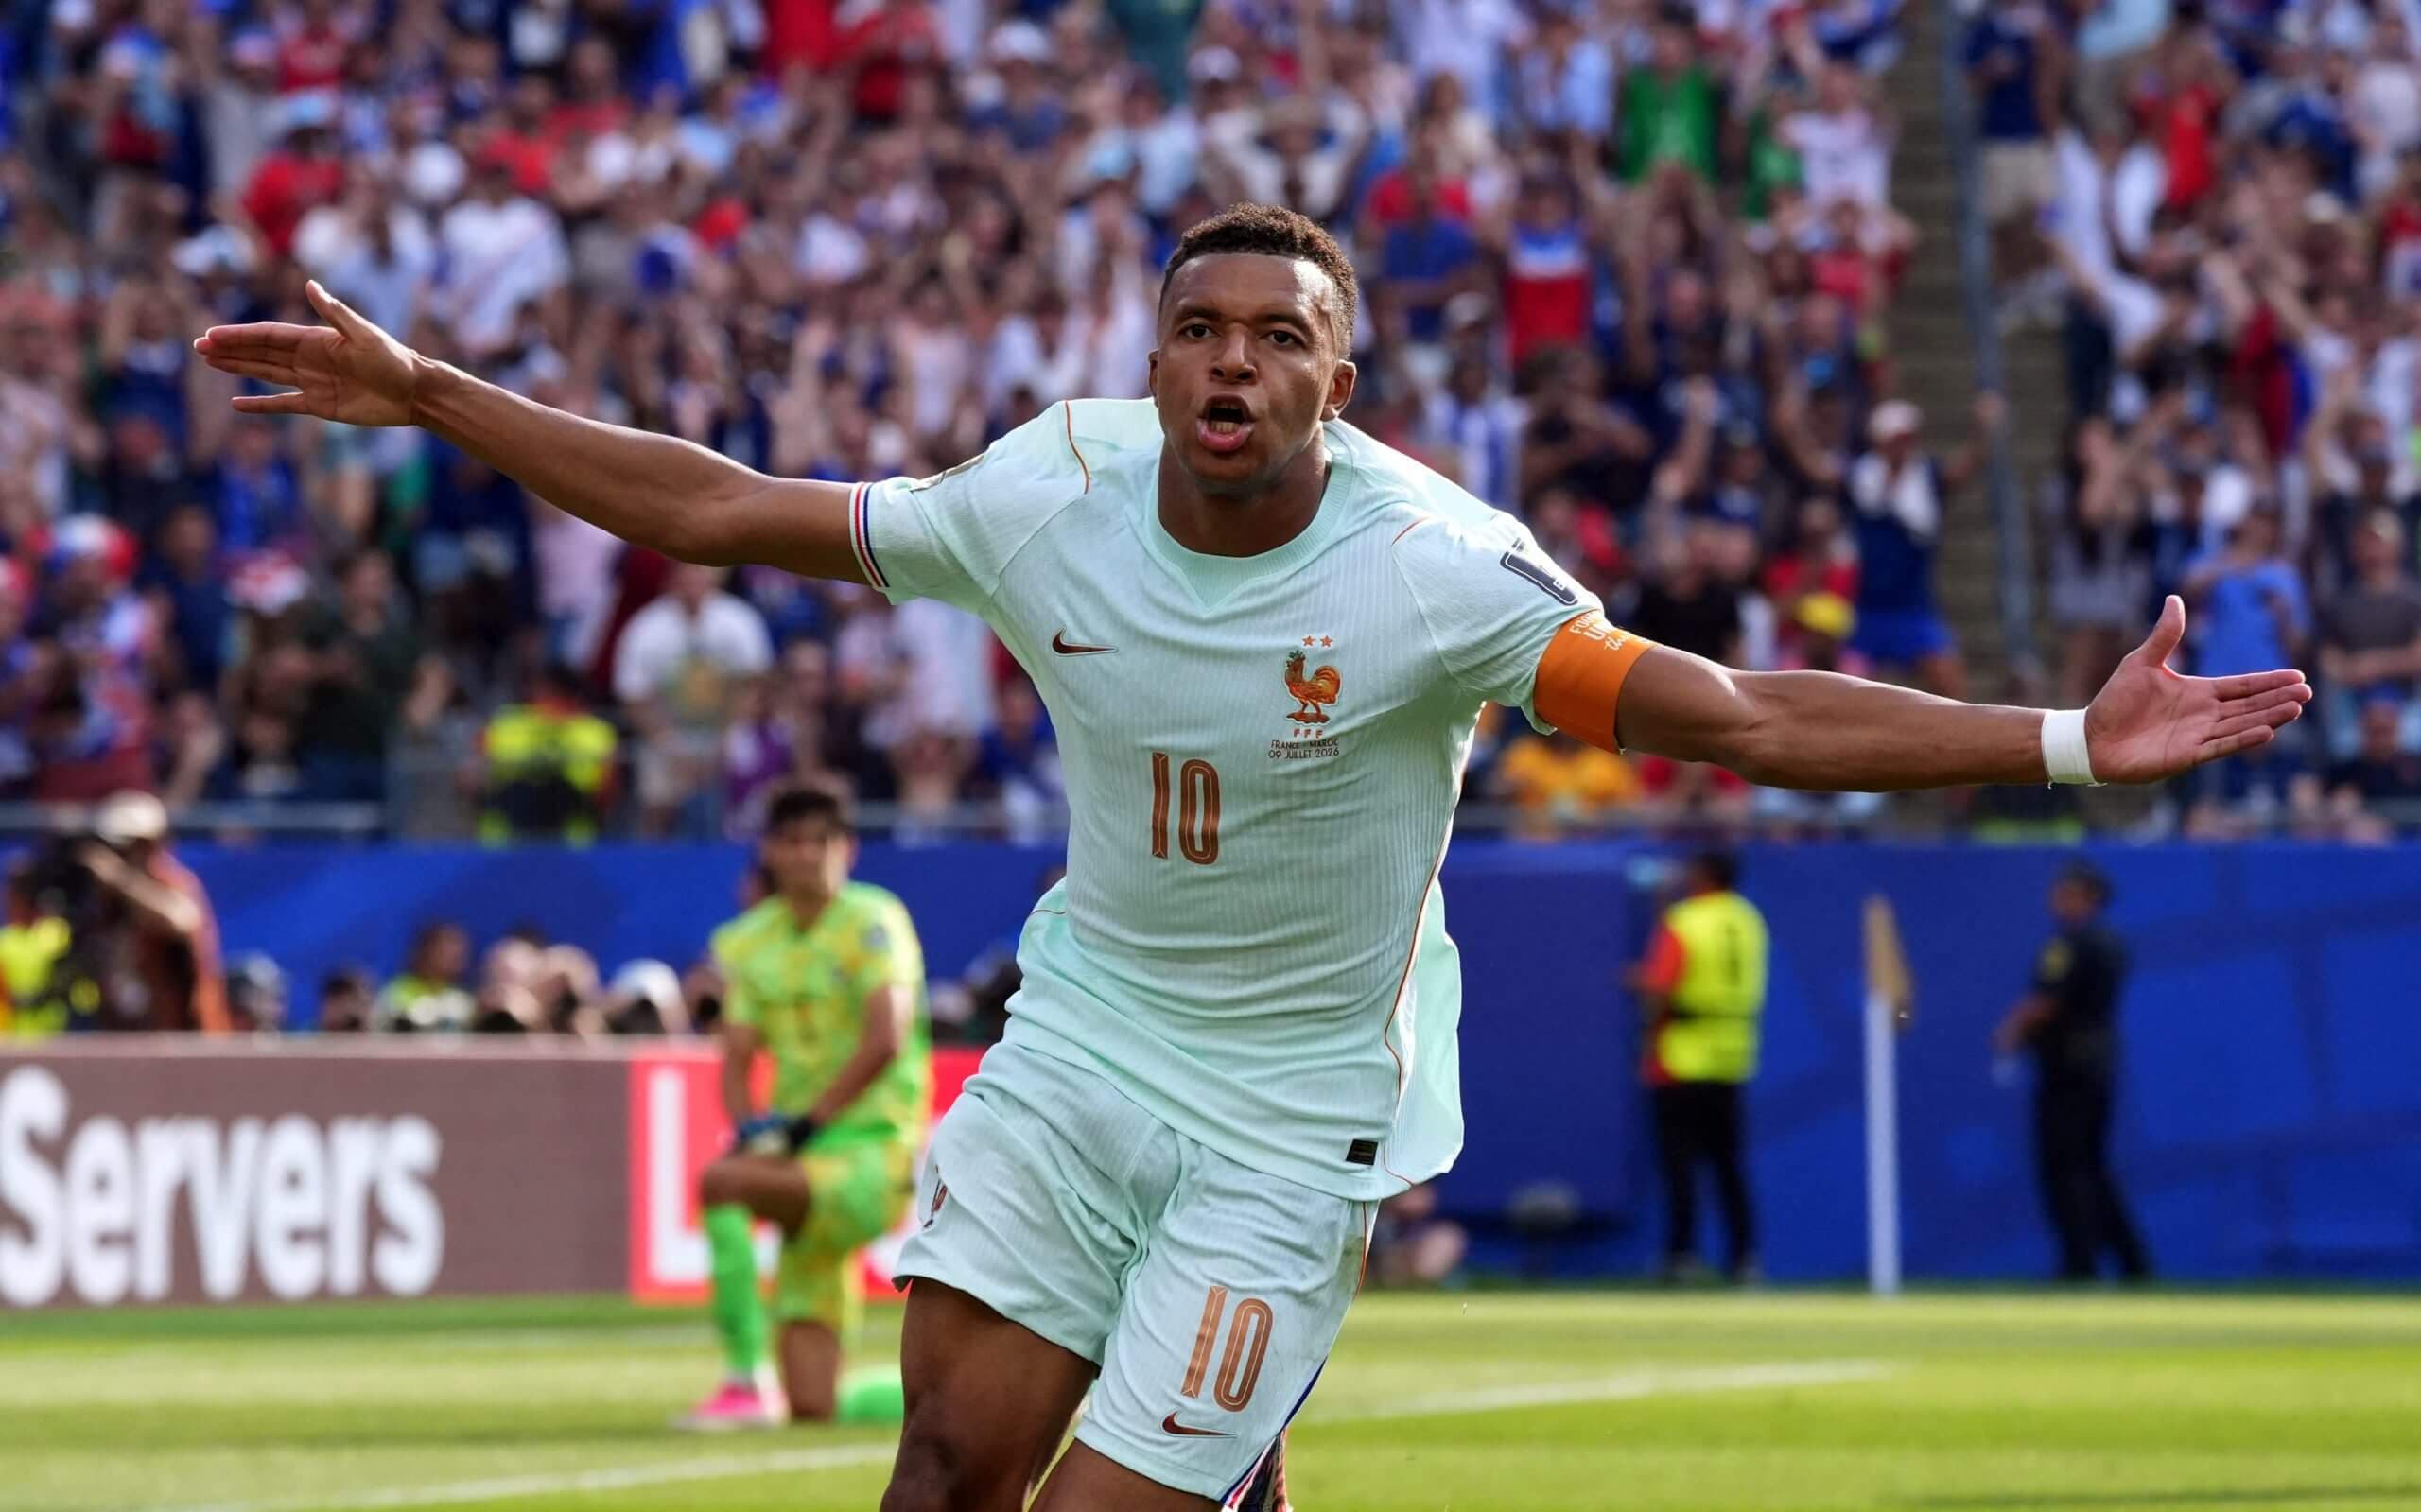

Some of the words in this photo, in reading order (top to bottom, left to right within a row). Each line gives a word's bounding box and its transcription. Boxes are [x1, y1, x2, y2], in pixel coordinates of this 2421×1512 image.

[1268, 750, 1282, 758] 09
[1285, 749, 1312, 759] JUILLET
[1315, 748, 1339, 757] 2026
[1271, 739, 1301, 749] FRANCE
[1309, 738, 1339, 747] MAROC
[1151, 750, 1221, 865] 10
[0, 1065, 445, 1308] Servers
[1180, 1285, 1274, 1413] 10
